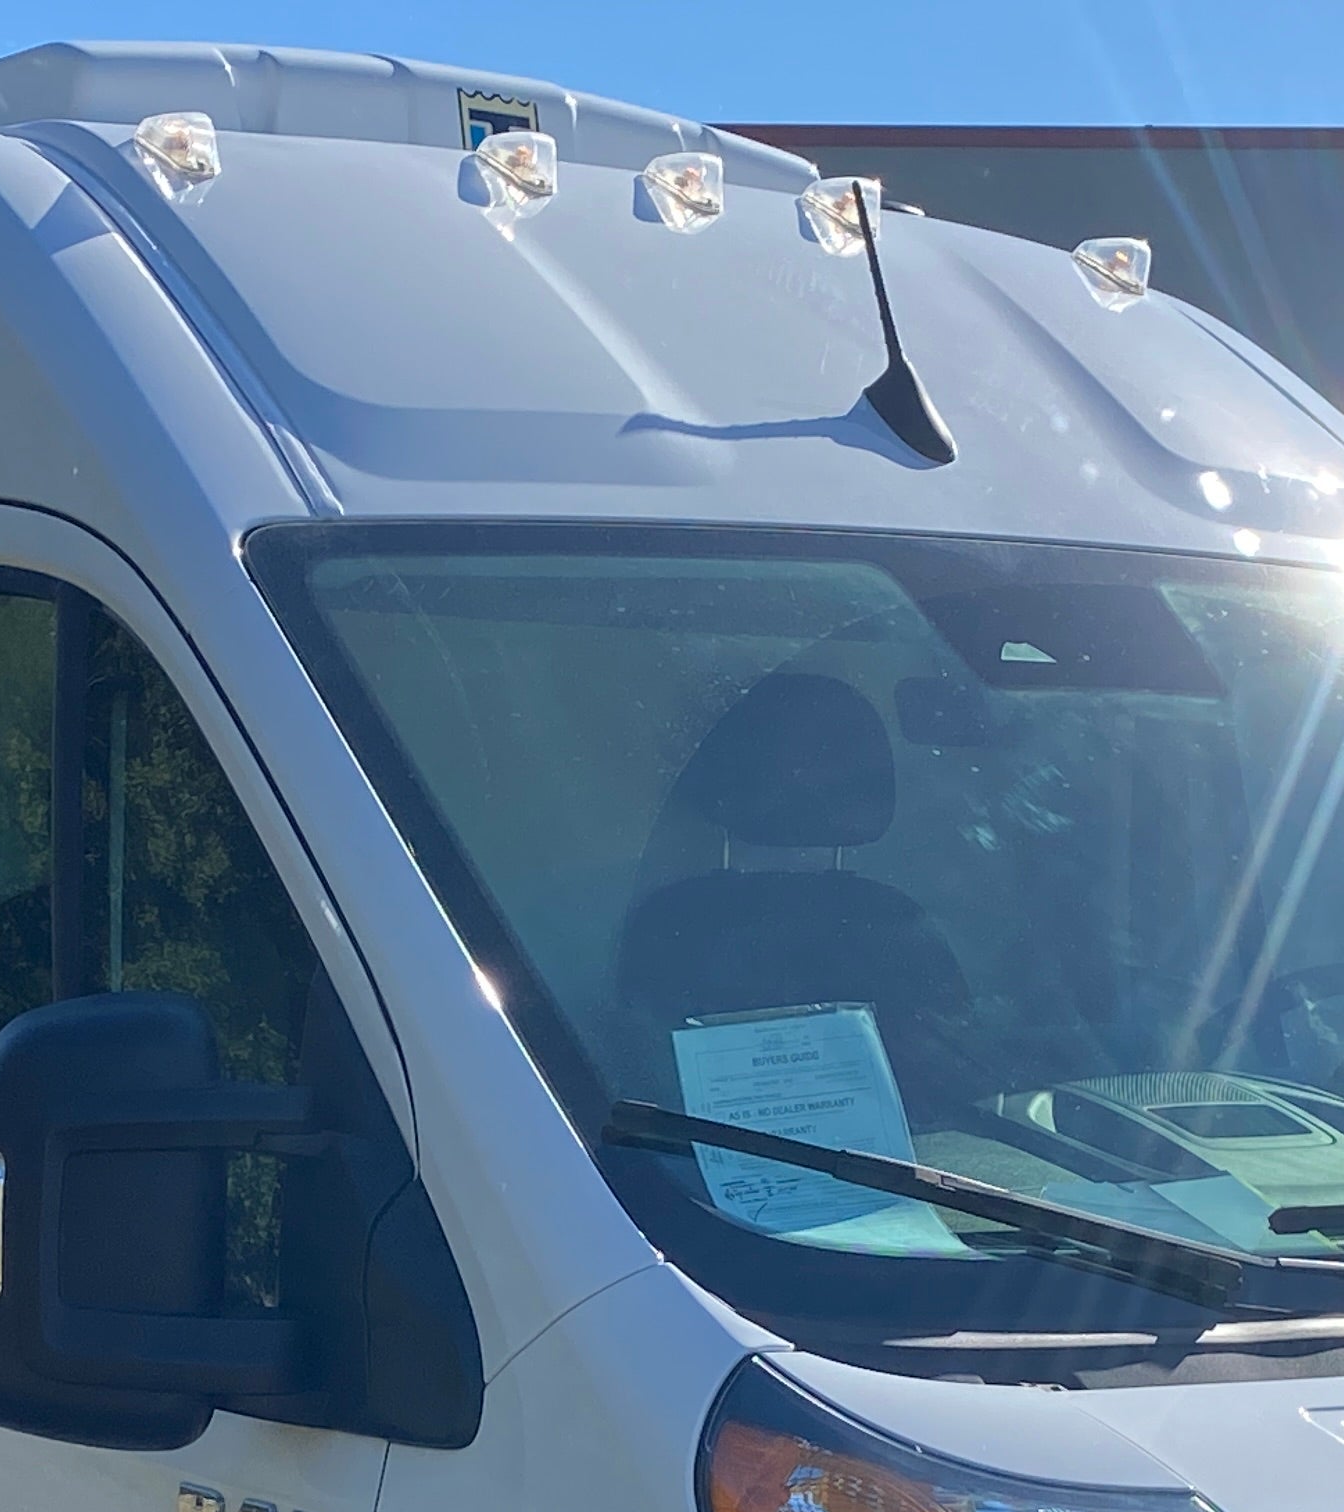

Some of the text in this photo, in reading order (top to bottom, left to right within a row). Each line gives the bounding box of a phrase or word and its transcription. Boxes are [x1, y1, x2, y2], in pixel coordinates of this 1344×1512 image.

[752, 1054, 789, 1067] BUYERS
[729, 1111, 741, 1121] AS
[807, 1097, 855, 1112] WARRANTY
